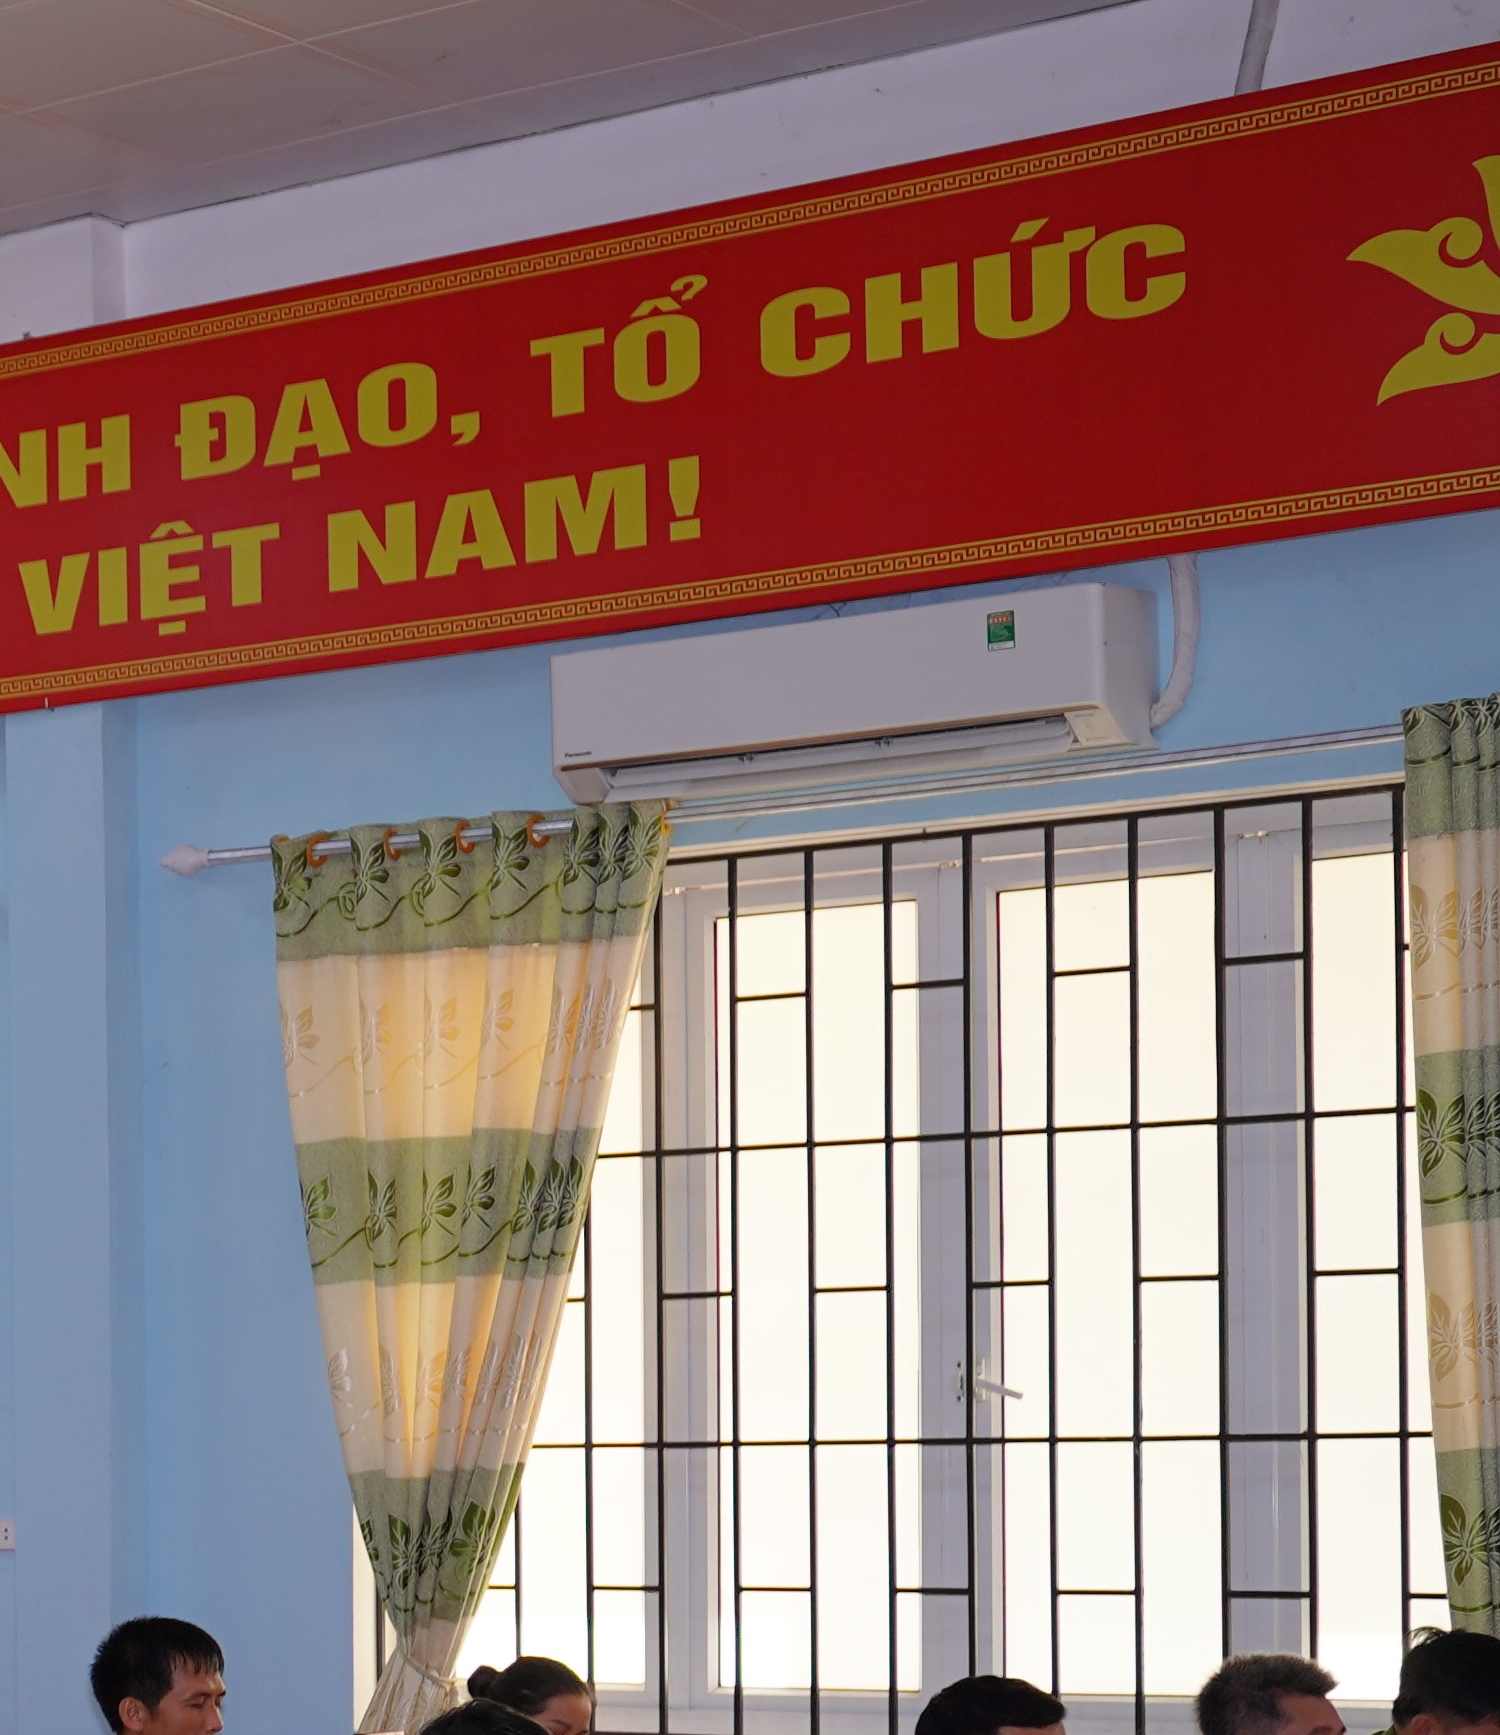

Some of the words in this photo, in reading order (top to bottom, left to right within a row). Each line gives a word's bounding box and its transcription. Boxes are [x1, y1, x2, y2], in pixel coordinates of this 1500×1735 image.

[175, 362, 480, 480] ĐẠO,
[530, 274, 708, 417] TỔ
[760, 218, 1186, 377] CHỨC
[18, 521, 280, 635] VIỆT
[327, 456, 701, 592] NAM!
